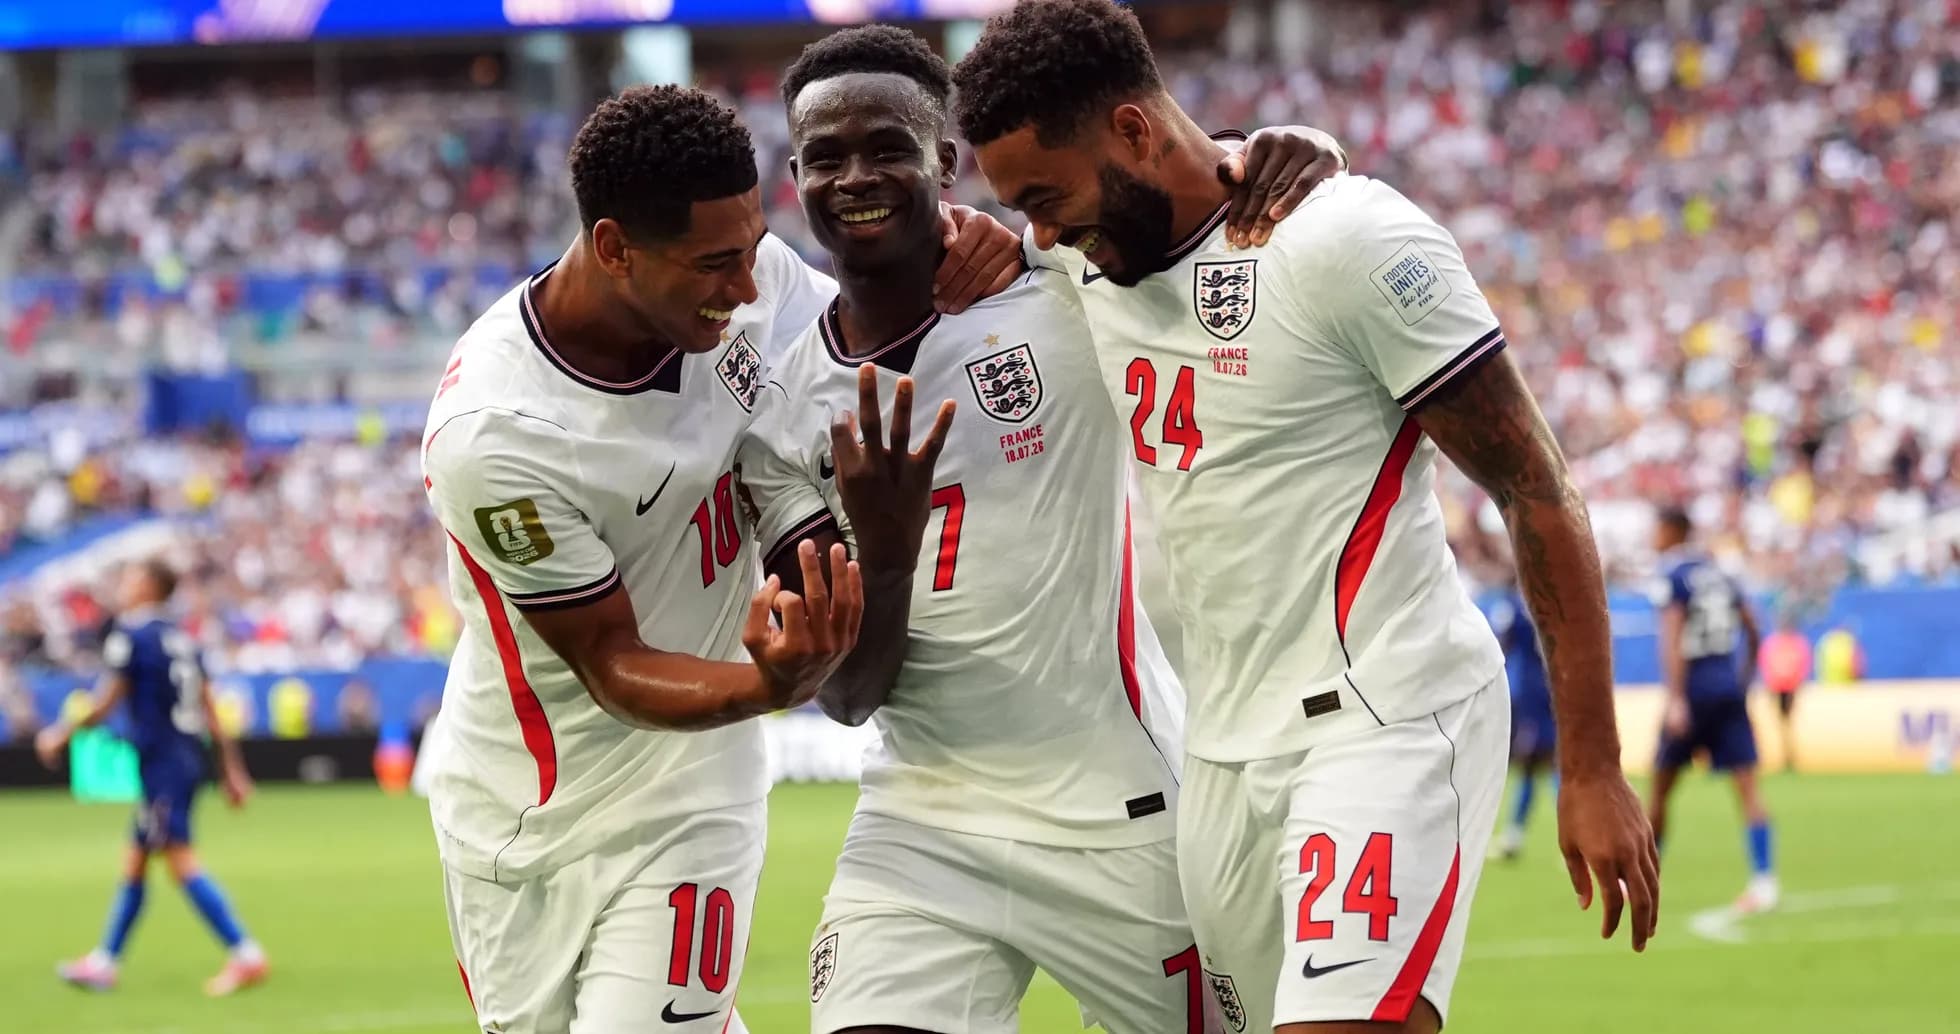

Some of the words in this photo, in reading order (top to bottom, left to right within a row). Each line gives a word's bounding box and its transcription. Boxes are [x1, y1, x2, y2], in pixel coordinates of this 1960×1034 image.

[1382, 252, 1419, 284] FOOTBALL
[1390, 260, 1429, 296] UNITES
[1400, 295, 1416, 309] the
[1413, 270, 1440, 298] World
[1418, 294, 1434, 307] FIFA
[1207, 347, 1249, 361] FRANCE
[1213, 359, 1248, 377] 18.07.26
[1124, 356, 1203, 472] 24
[999, 424, 1044, 449] FRANCE
[1004, 440, 1045, 464] 18.07.26
[689, 470, 742, 590] 10
[930, 482, 966, 593] 7
[1295, 831, 1398, 943] 24
[667, 881, 735, 995] 10
